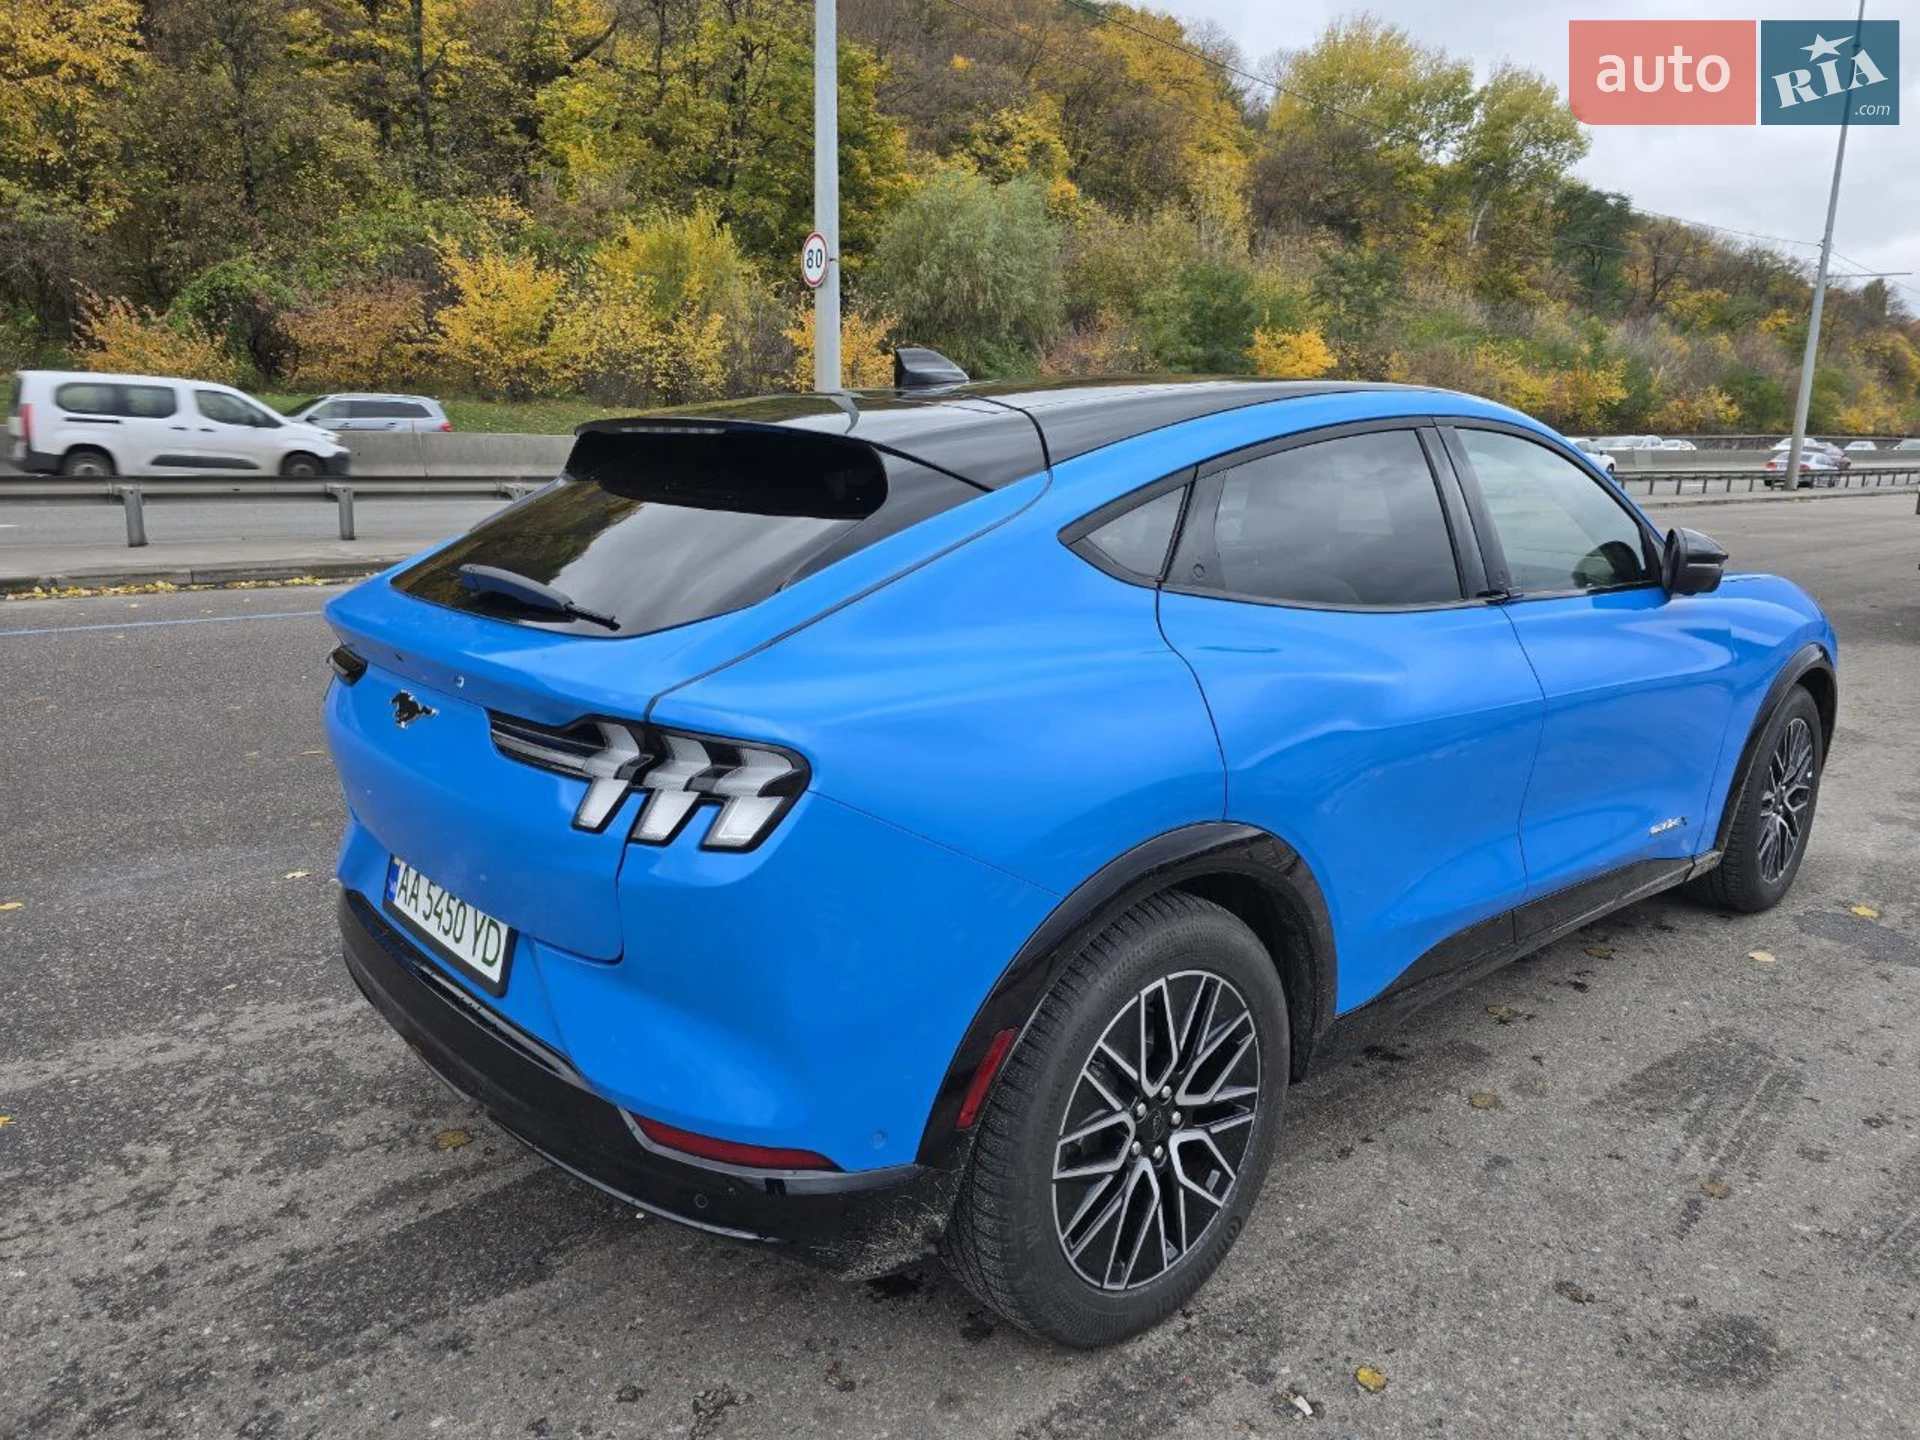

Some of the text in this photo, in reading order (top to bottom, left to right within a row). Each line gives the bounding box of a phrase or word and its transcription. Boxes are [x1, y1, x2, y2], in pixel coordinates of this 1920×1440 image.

[807, 249, 823, 268] 80
[397, 865, 501, 967] AA 5450 YD
